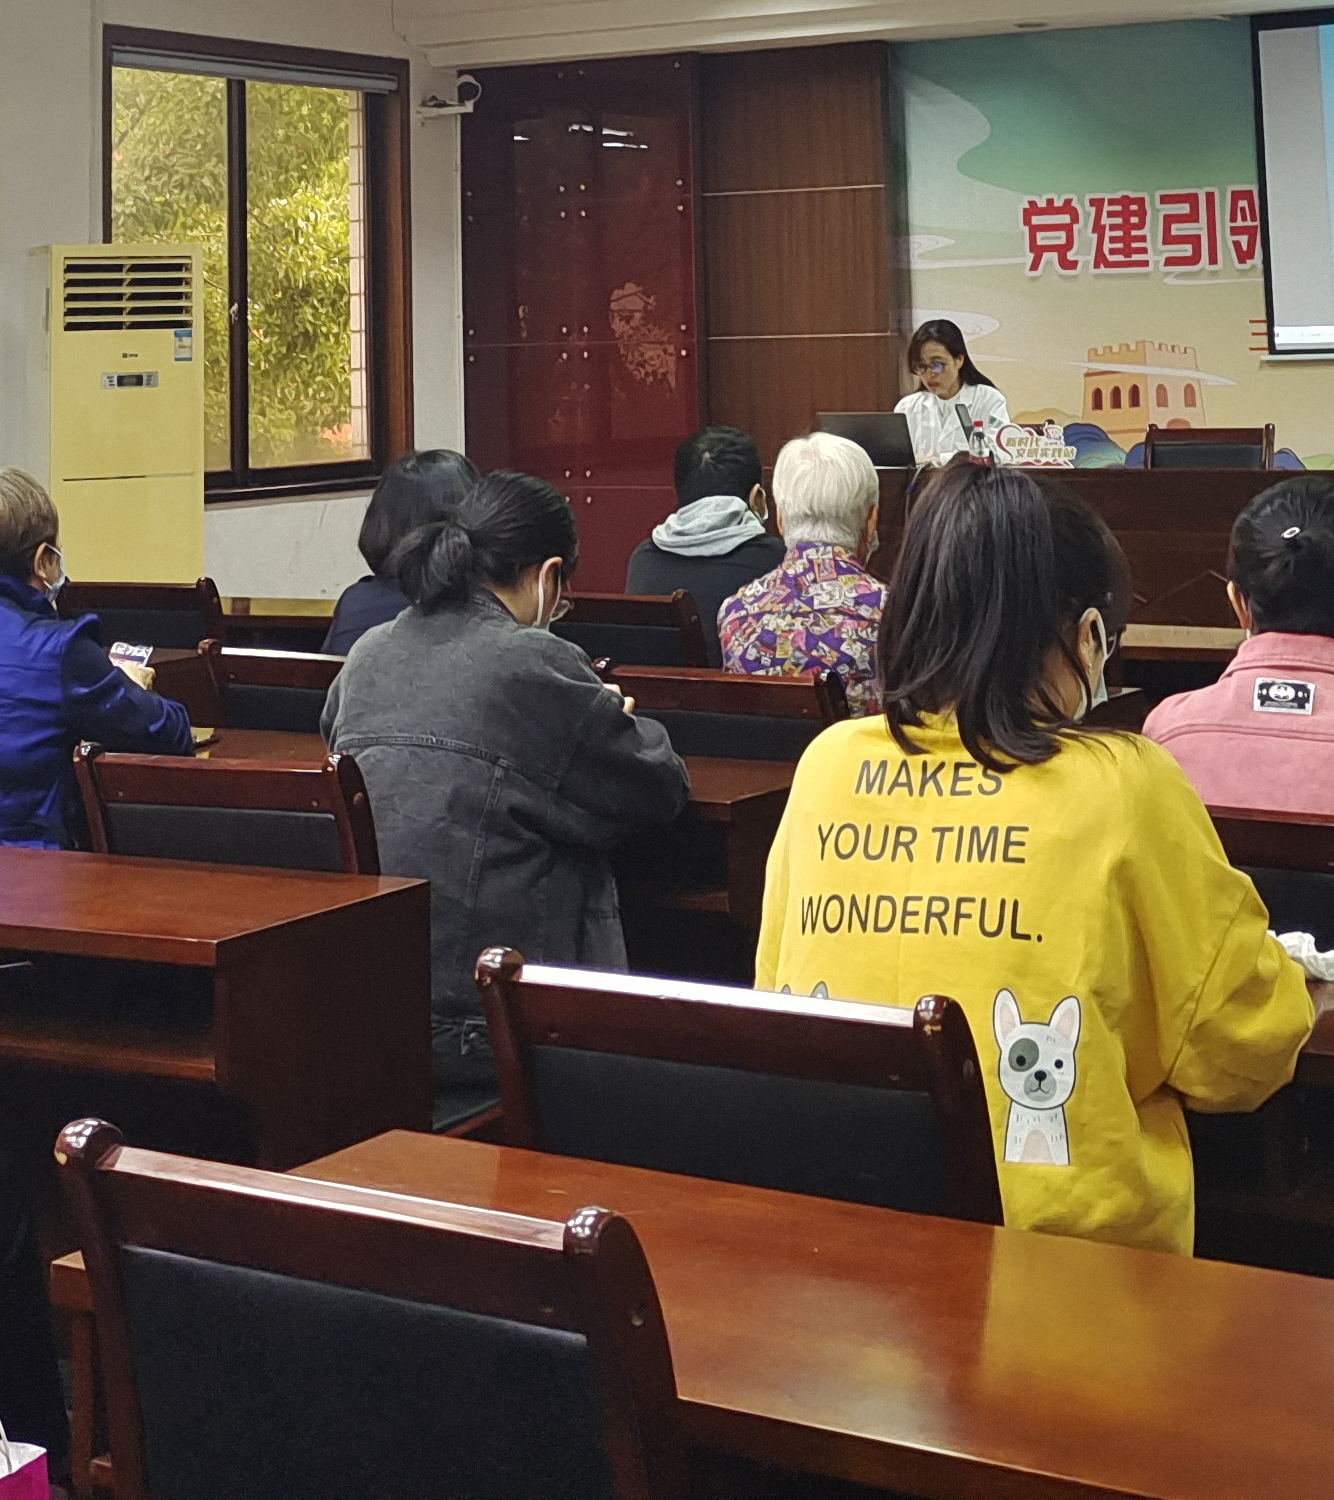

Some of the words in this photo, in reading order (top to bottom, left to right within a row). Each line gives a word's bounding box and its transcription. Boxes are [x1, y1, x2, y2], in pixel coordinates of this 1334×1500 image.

[854, 759, 1003, 797] MAKES
[817, 822, 918, 862] YOUR
[931, 825, 1029, 864] TIME
[800, 893, 1044, 942] WONDERFUL.
